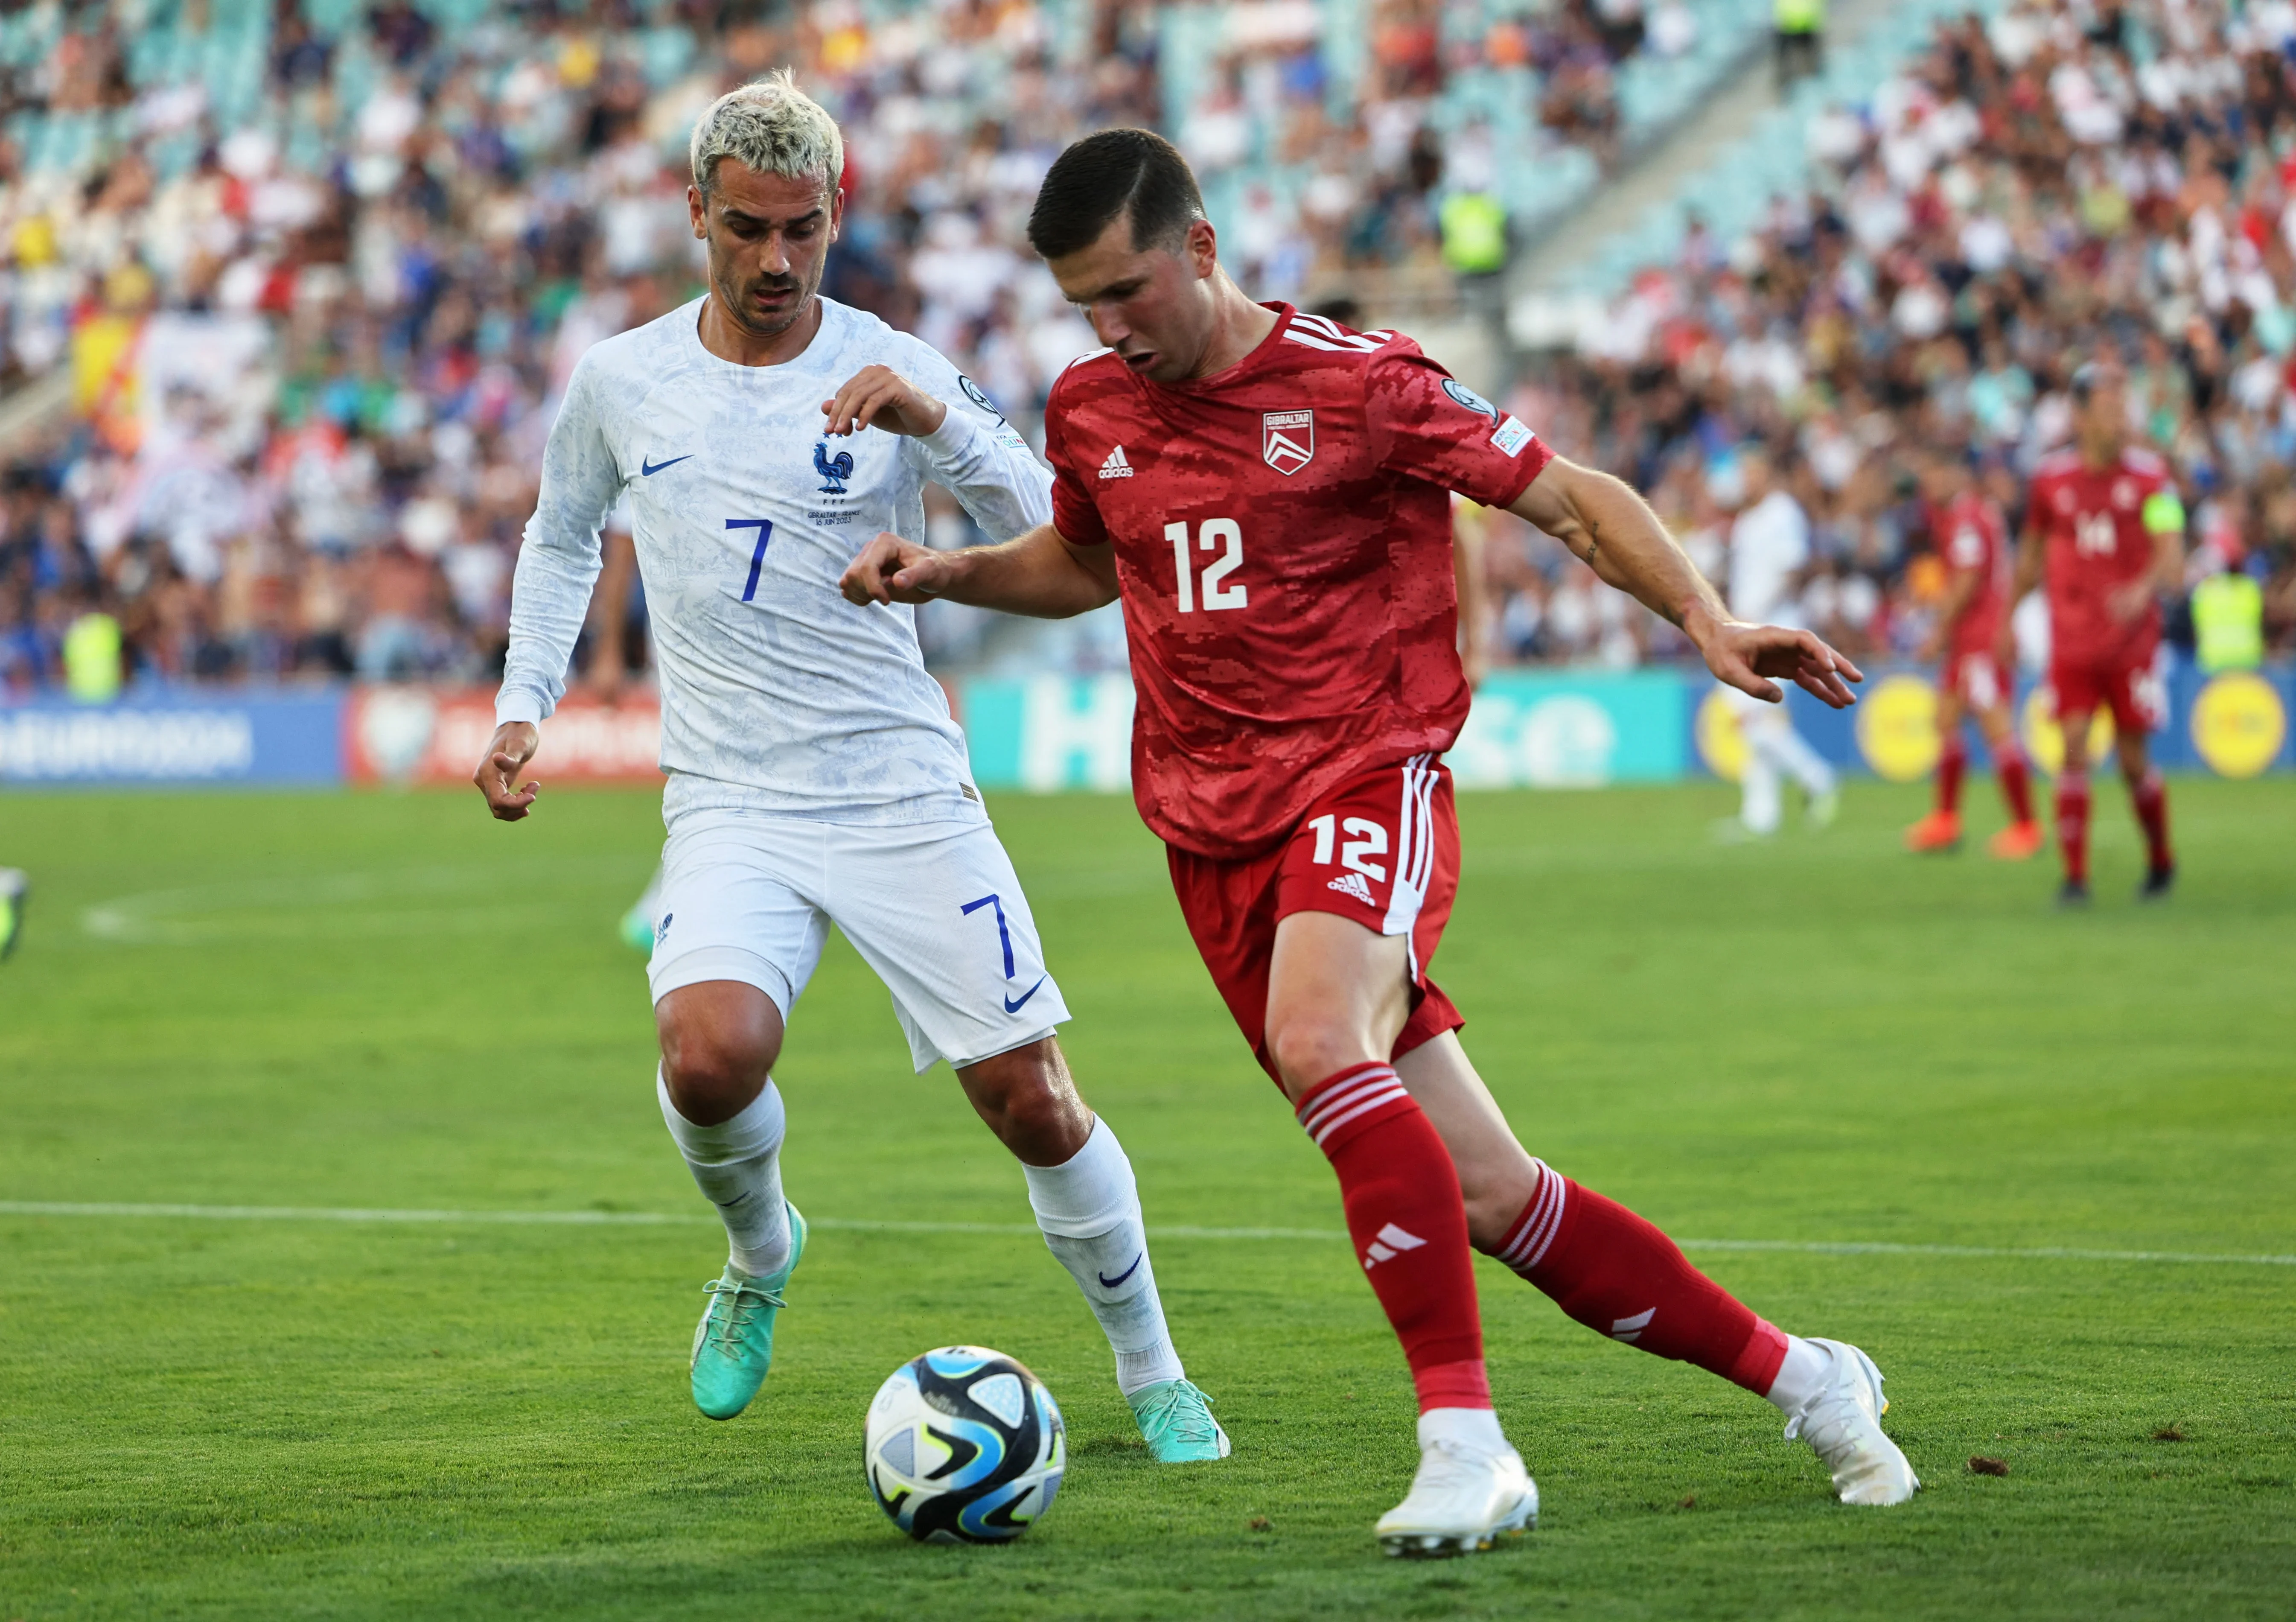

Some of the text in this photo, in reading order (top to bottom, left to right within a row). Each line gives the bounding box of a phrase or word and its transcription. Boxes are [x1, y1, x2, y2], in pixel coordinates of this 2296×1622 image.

[1267, 413, 1309, 426] GIBRALTAR
[1098, 466, 1134, 479] adidas
[836, 516, 851, 525] 2023
[725, 519, 773, 602] 7
[1164, 518, 1247, 613] 12
[1308, 814, 1388, 883] 12
[1327, 880, 1375, 907] adidas
[960, 893, 1015, 980] 7
